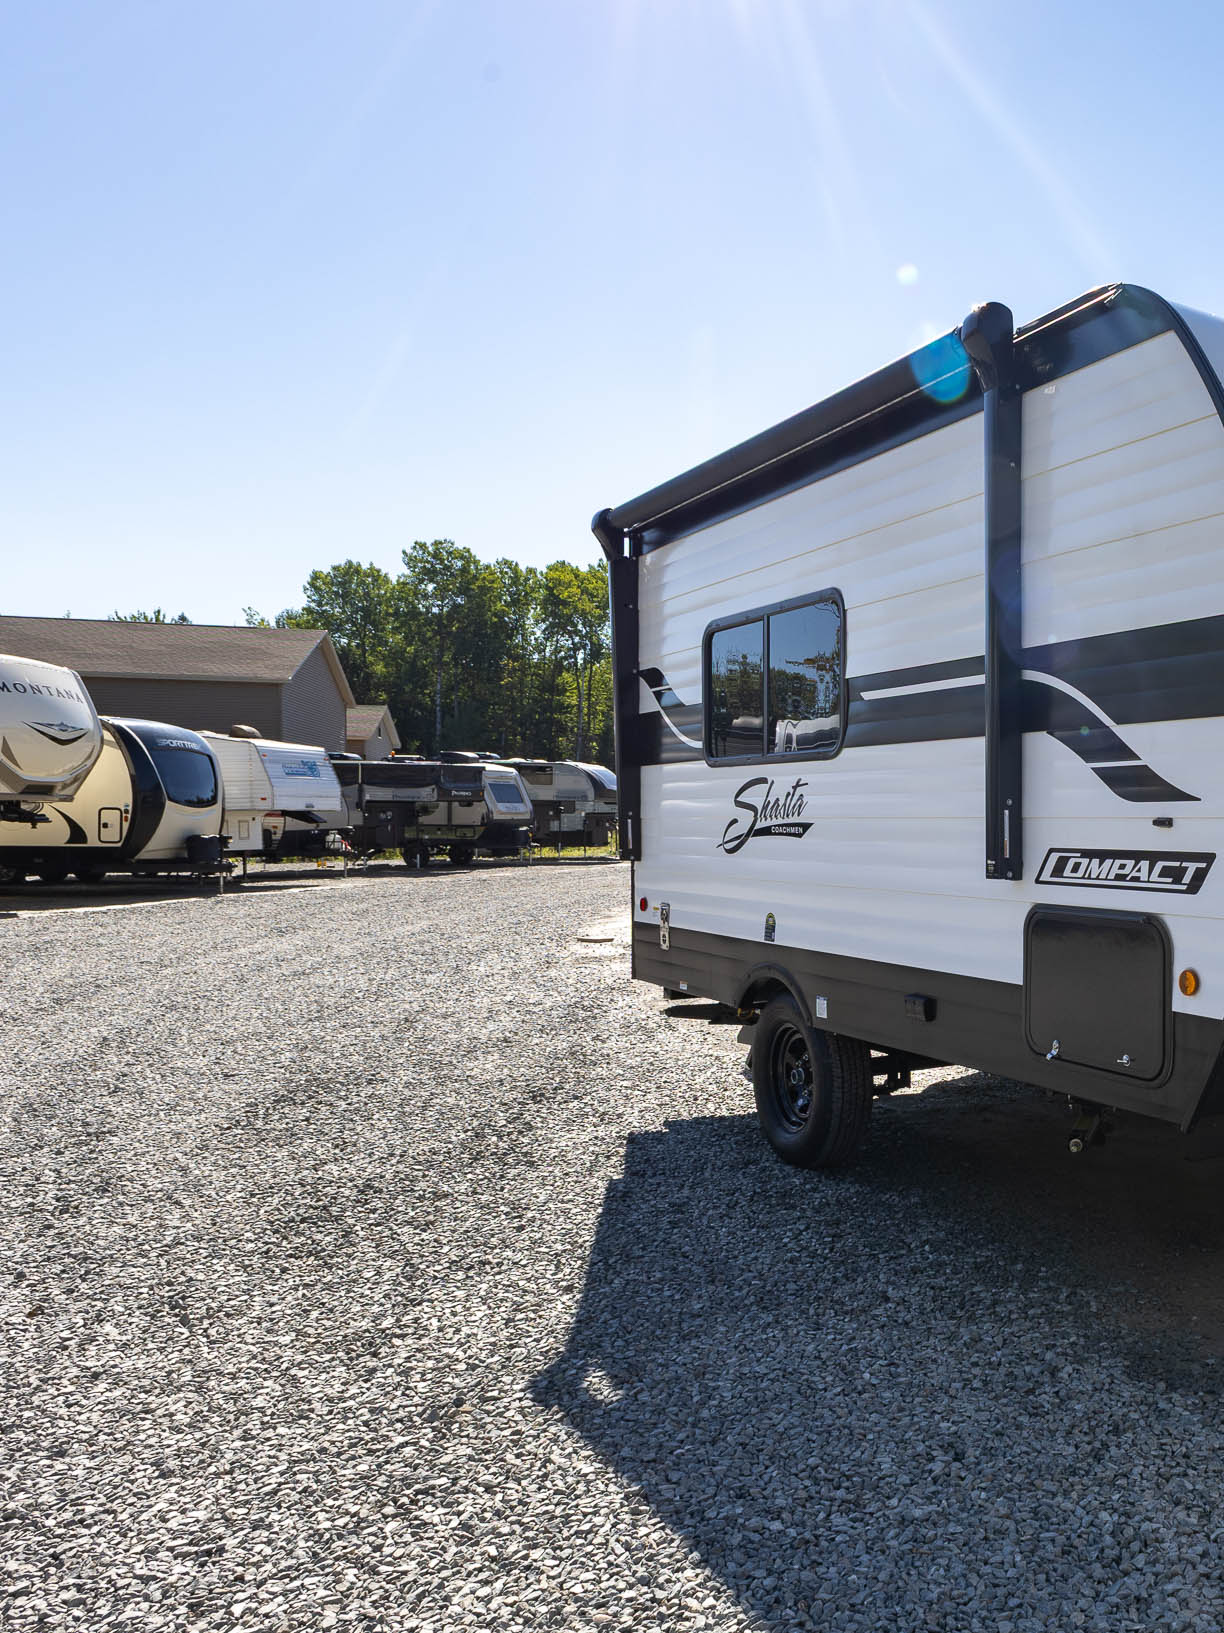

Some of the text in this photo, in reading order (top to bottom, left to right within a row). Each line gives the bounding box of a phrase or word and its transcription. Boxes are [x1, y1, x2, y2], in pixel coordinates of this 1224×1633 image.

[0, 681, 83, 703] MONTANA
[723, 776, 808, 854] Shasta
[771, 826, 804, 834] COACHMEN
[1039, 852, 1207, 890] COMPACT
